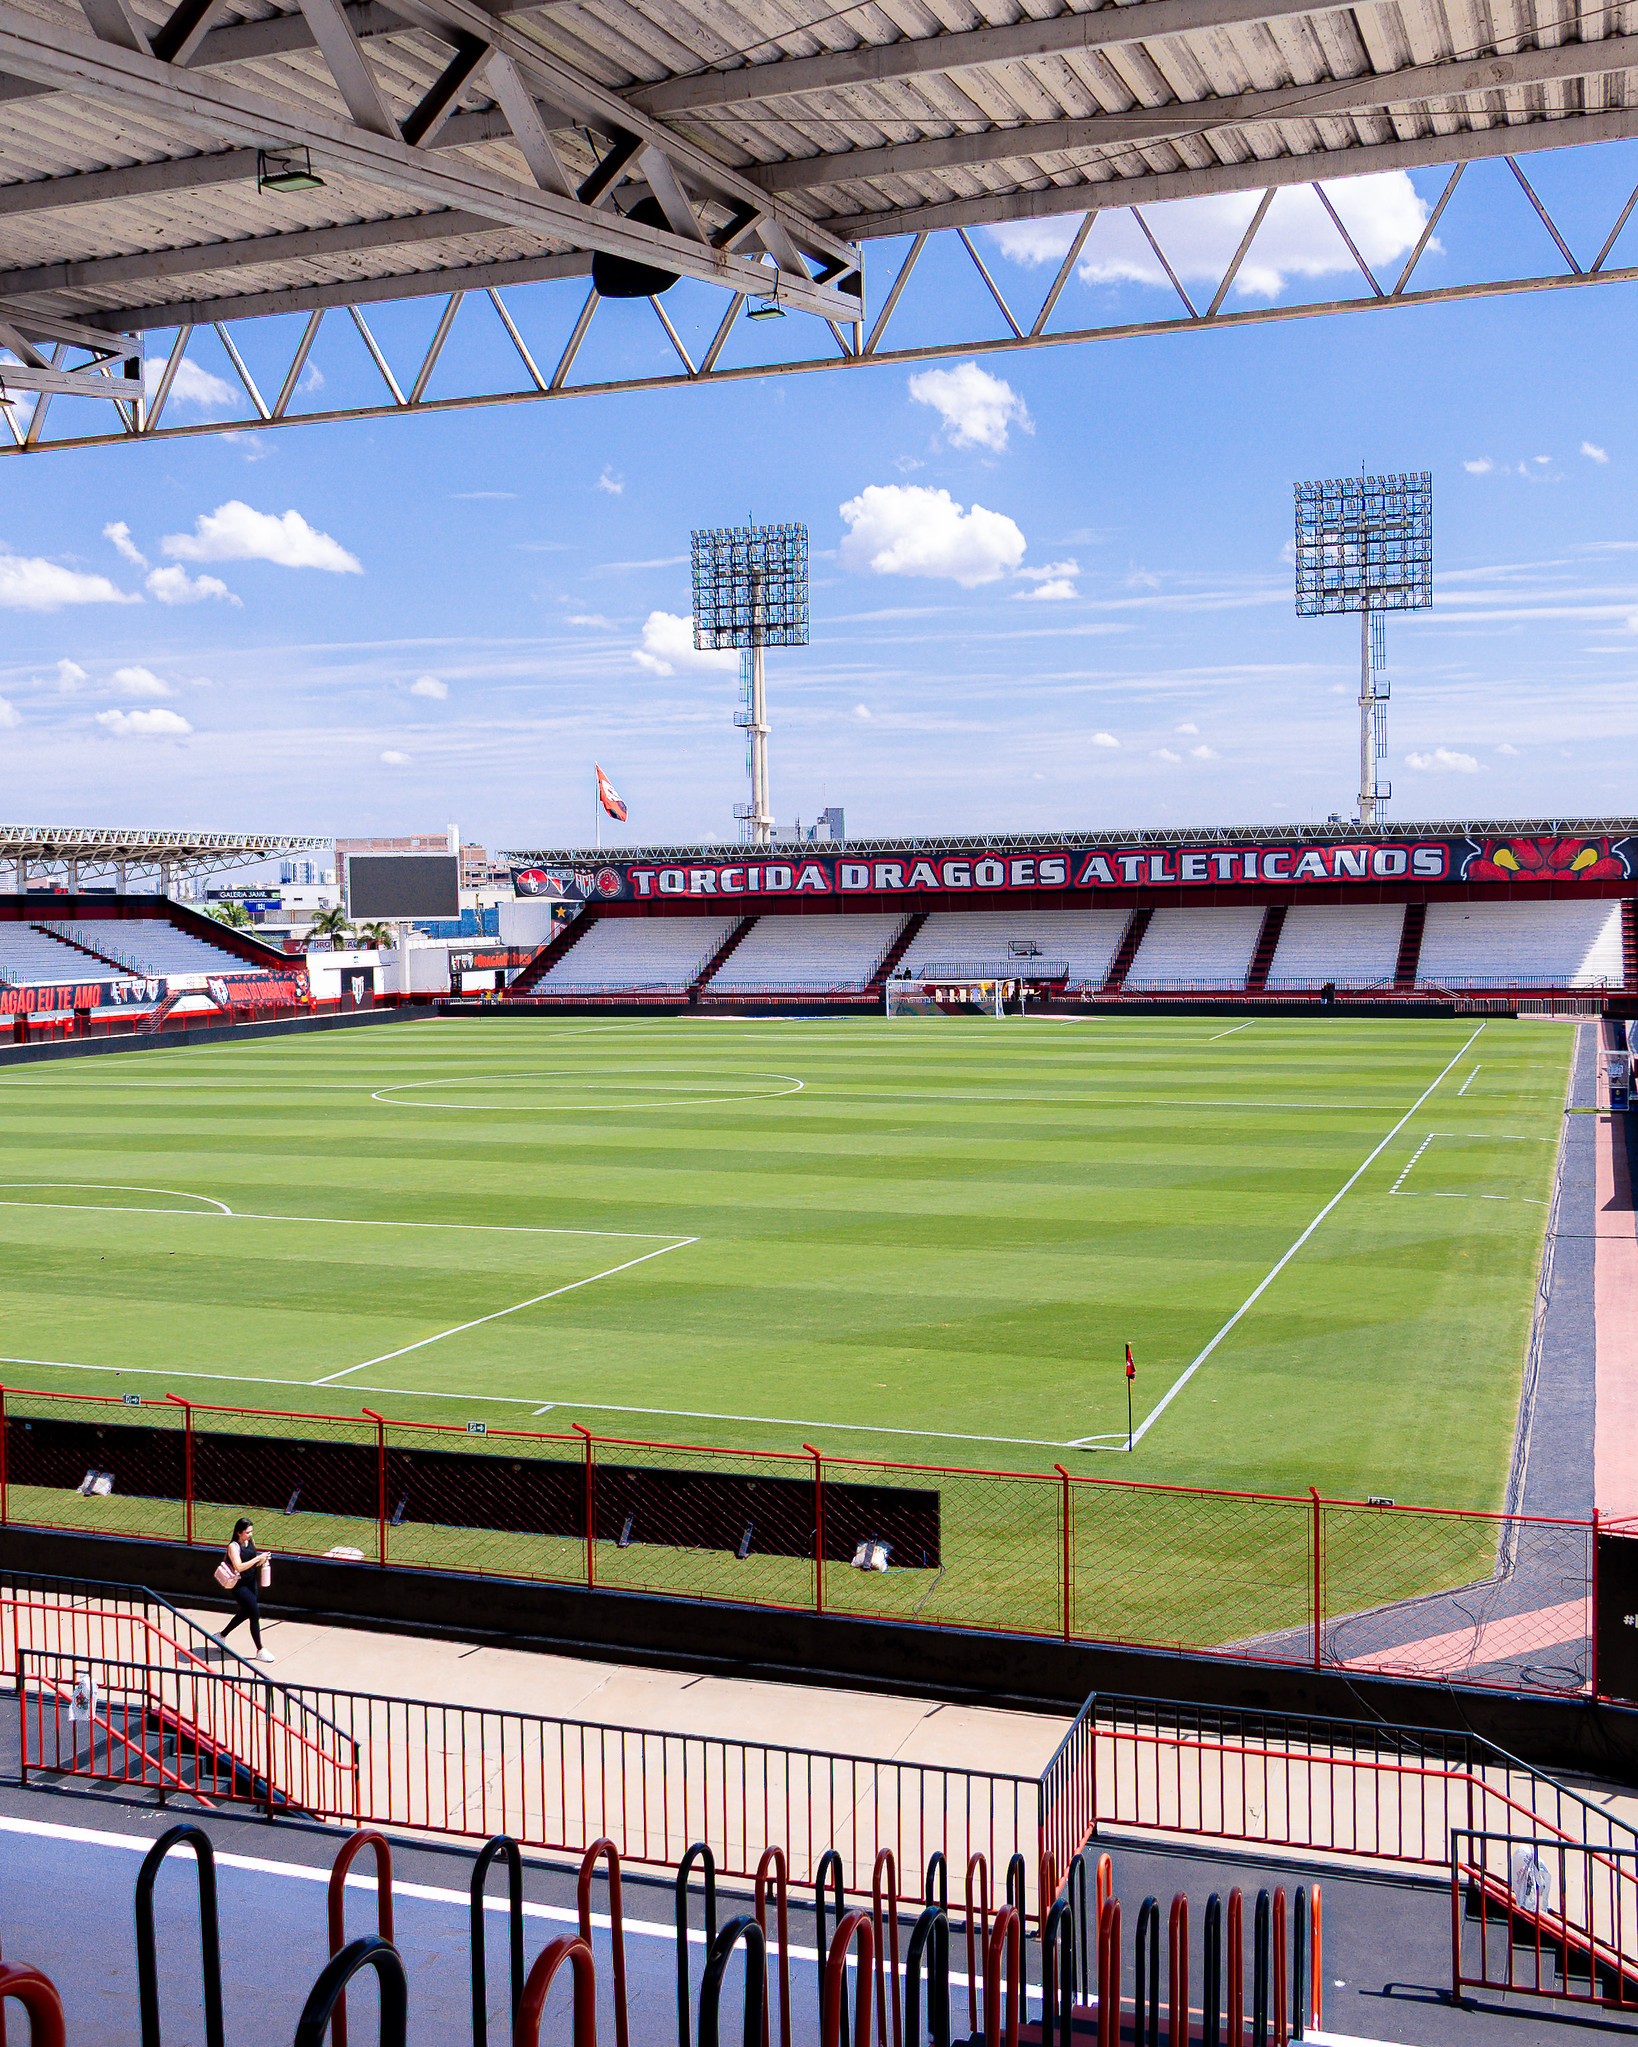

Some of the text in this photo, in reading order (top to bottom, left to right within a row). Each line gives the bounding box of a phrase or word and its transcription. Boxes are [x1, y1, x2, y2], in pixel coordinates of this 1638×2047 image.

[632, 865, 827, 895] TORCIDA
[841, 858, 1066, 890] DRAGÕES
[1080, 849, 1444, 883] ATLETICANOS
[37, 986, 55, 1012] EU
[57, 985, 72, 1010] TE
[73, 984, 102, 1009] AMO
